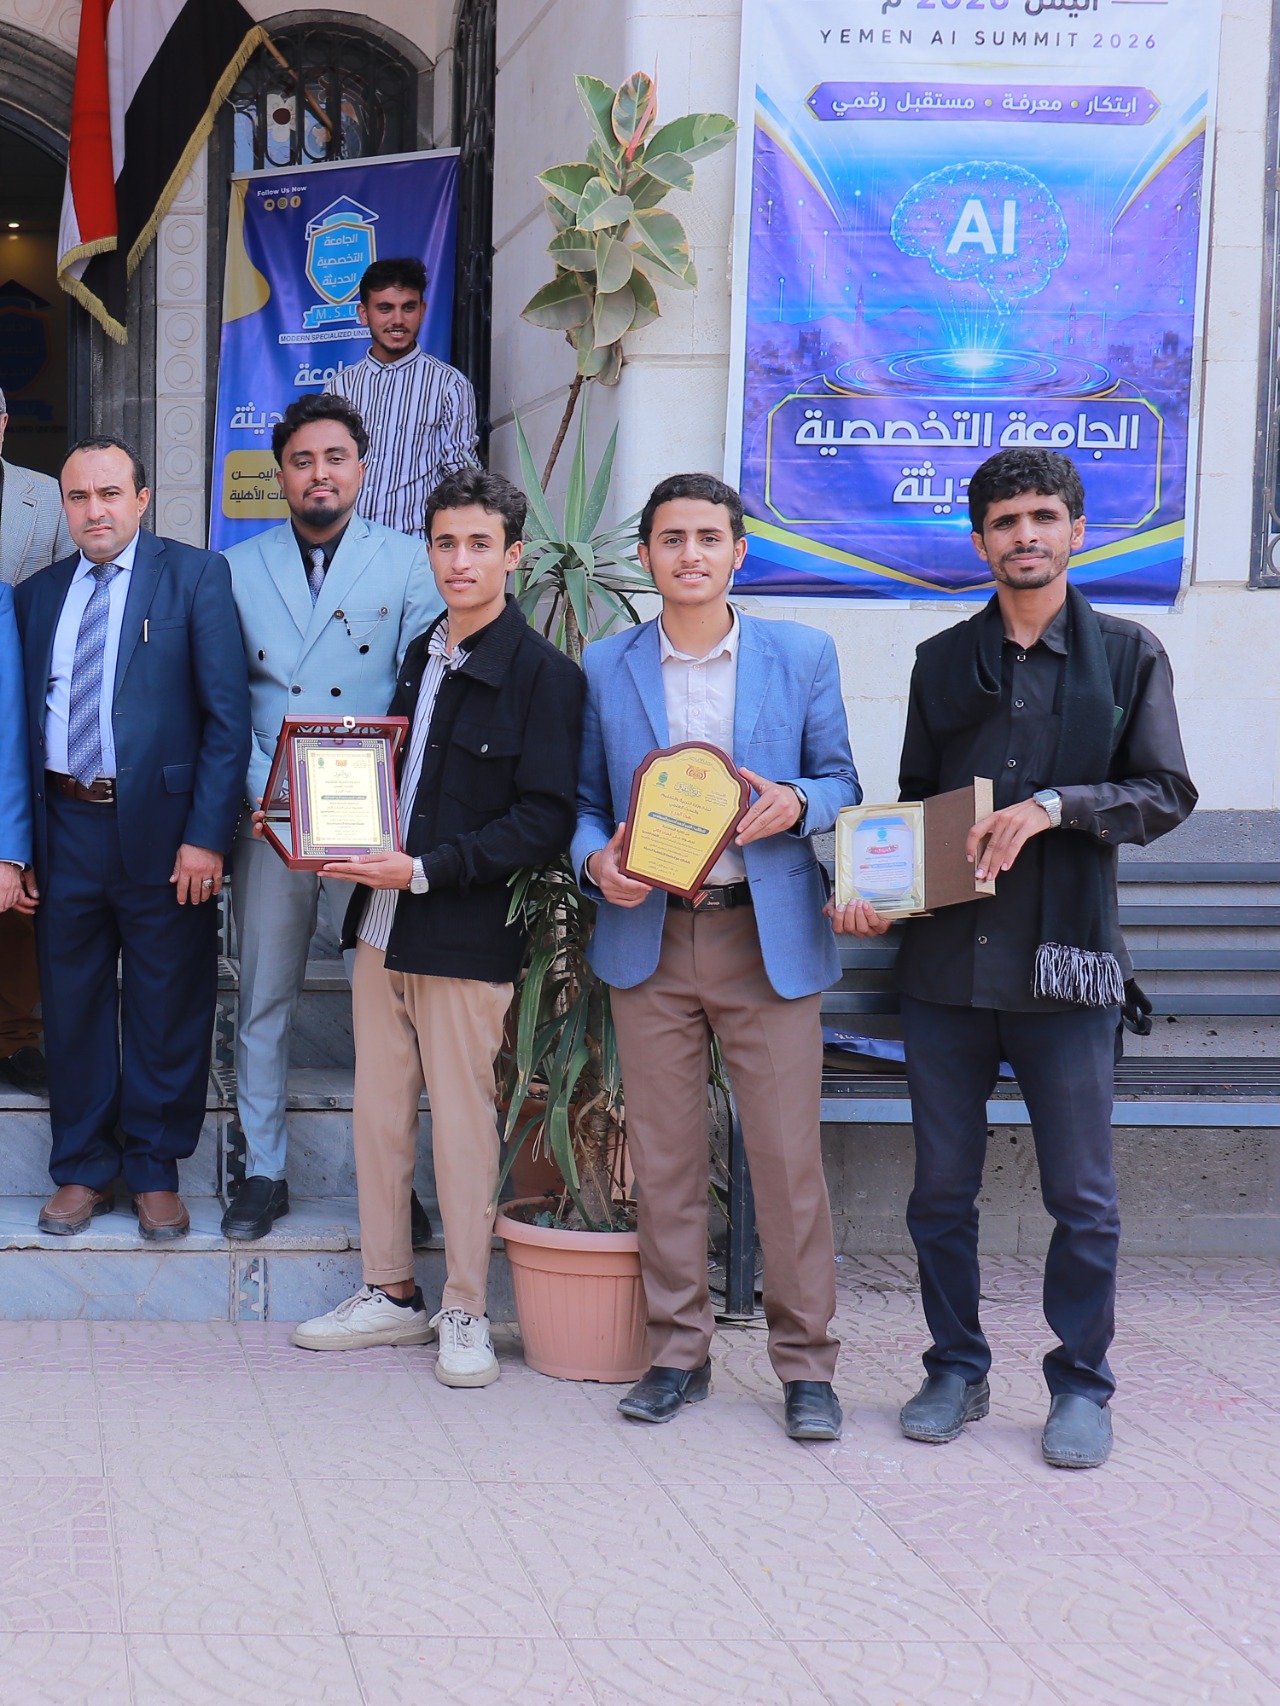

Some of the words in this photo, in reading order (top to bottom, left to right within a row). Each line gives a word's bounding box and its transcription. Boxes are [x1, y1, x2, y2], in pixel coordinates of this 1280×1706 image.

[820, 29, 913, 45] YEMEN
[930, 30, 956, 45] AI
[974, 30, 1078, 47] SUMMIT
[1092, 33, 1156, 49] 2026
[832, 91, 886, 116] رقمي
[896, 91, 975, 113] مستقبل
[1002, 92, 1062, 114] معرفة
[1085, 95, 1137, 116] ابتكار
[257, 188, 280, 197] Follow
[292, 185, 307, 193] Now
[946, 199, 1017, 254] AI
[323, 234, 358, 247] الجامعة
[317, 252, 363, 269] التخصصية
[322, 273, 357, 288] الحديثة
[316, 306, 357, 320] M.S.U
[280, 334, 310, 343] MODERN
[311, 331, 352, 341] SPECIALIZED
[353, 329, 372, 338] UNIV
[230, 401, 285, 435] ديثة
[795, 408, 992, 457] التخصصية
[999, 411, 1140, 459] الجامعة
[231, 468, 277, 481] اليمن
[229, 485, 265, 503] الأهلية
